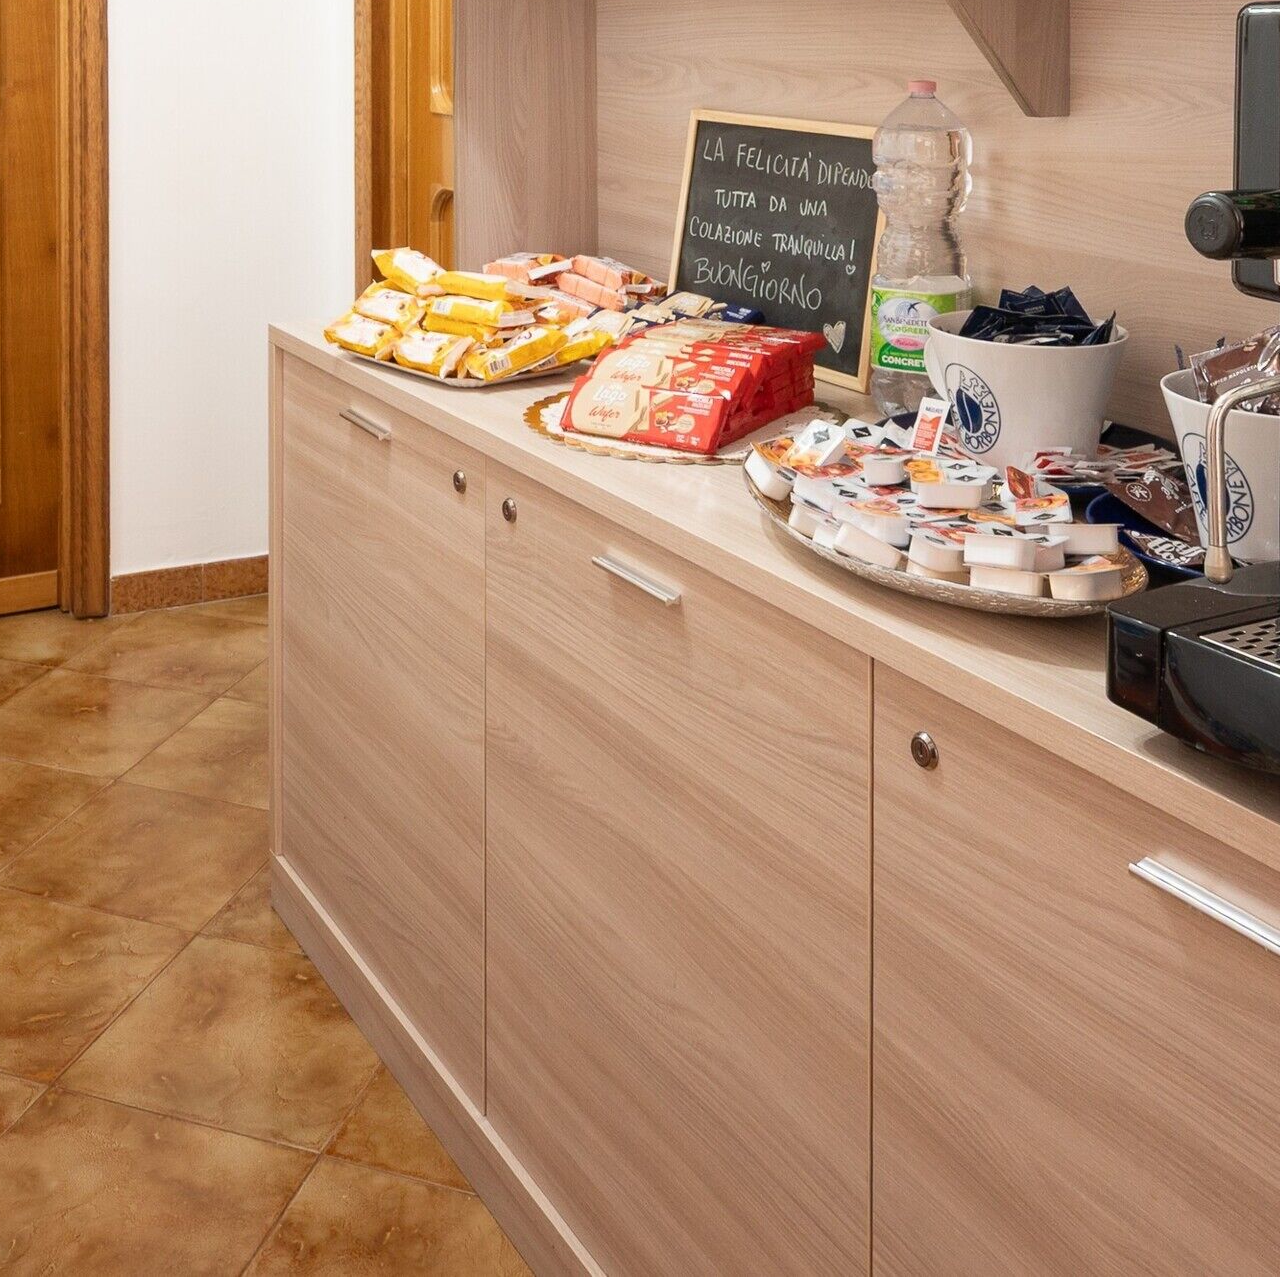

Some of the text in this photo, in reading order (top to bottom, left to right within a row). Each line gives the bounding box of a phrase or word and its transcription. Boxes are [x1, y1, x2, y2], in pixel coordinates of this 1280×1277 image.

[703, 137, 725, 162] LA
[714, 189, 827, 216] TUTTA DA UNA
[689, 215, 762, 248] COLAZIONE
[896, 317, 928, 327] BENEDETT
[881, 354, 926, 368] CONCRET
[588, 406, 621, 421] Wafer
[964, 401, 998, 450] BORBONE
